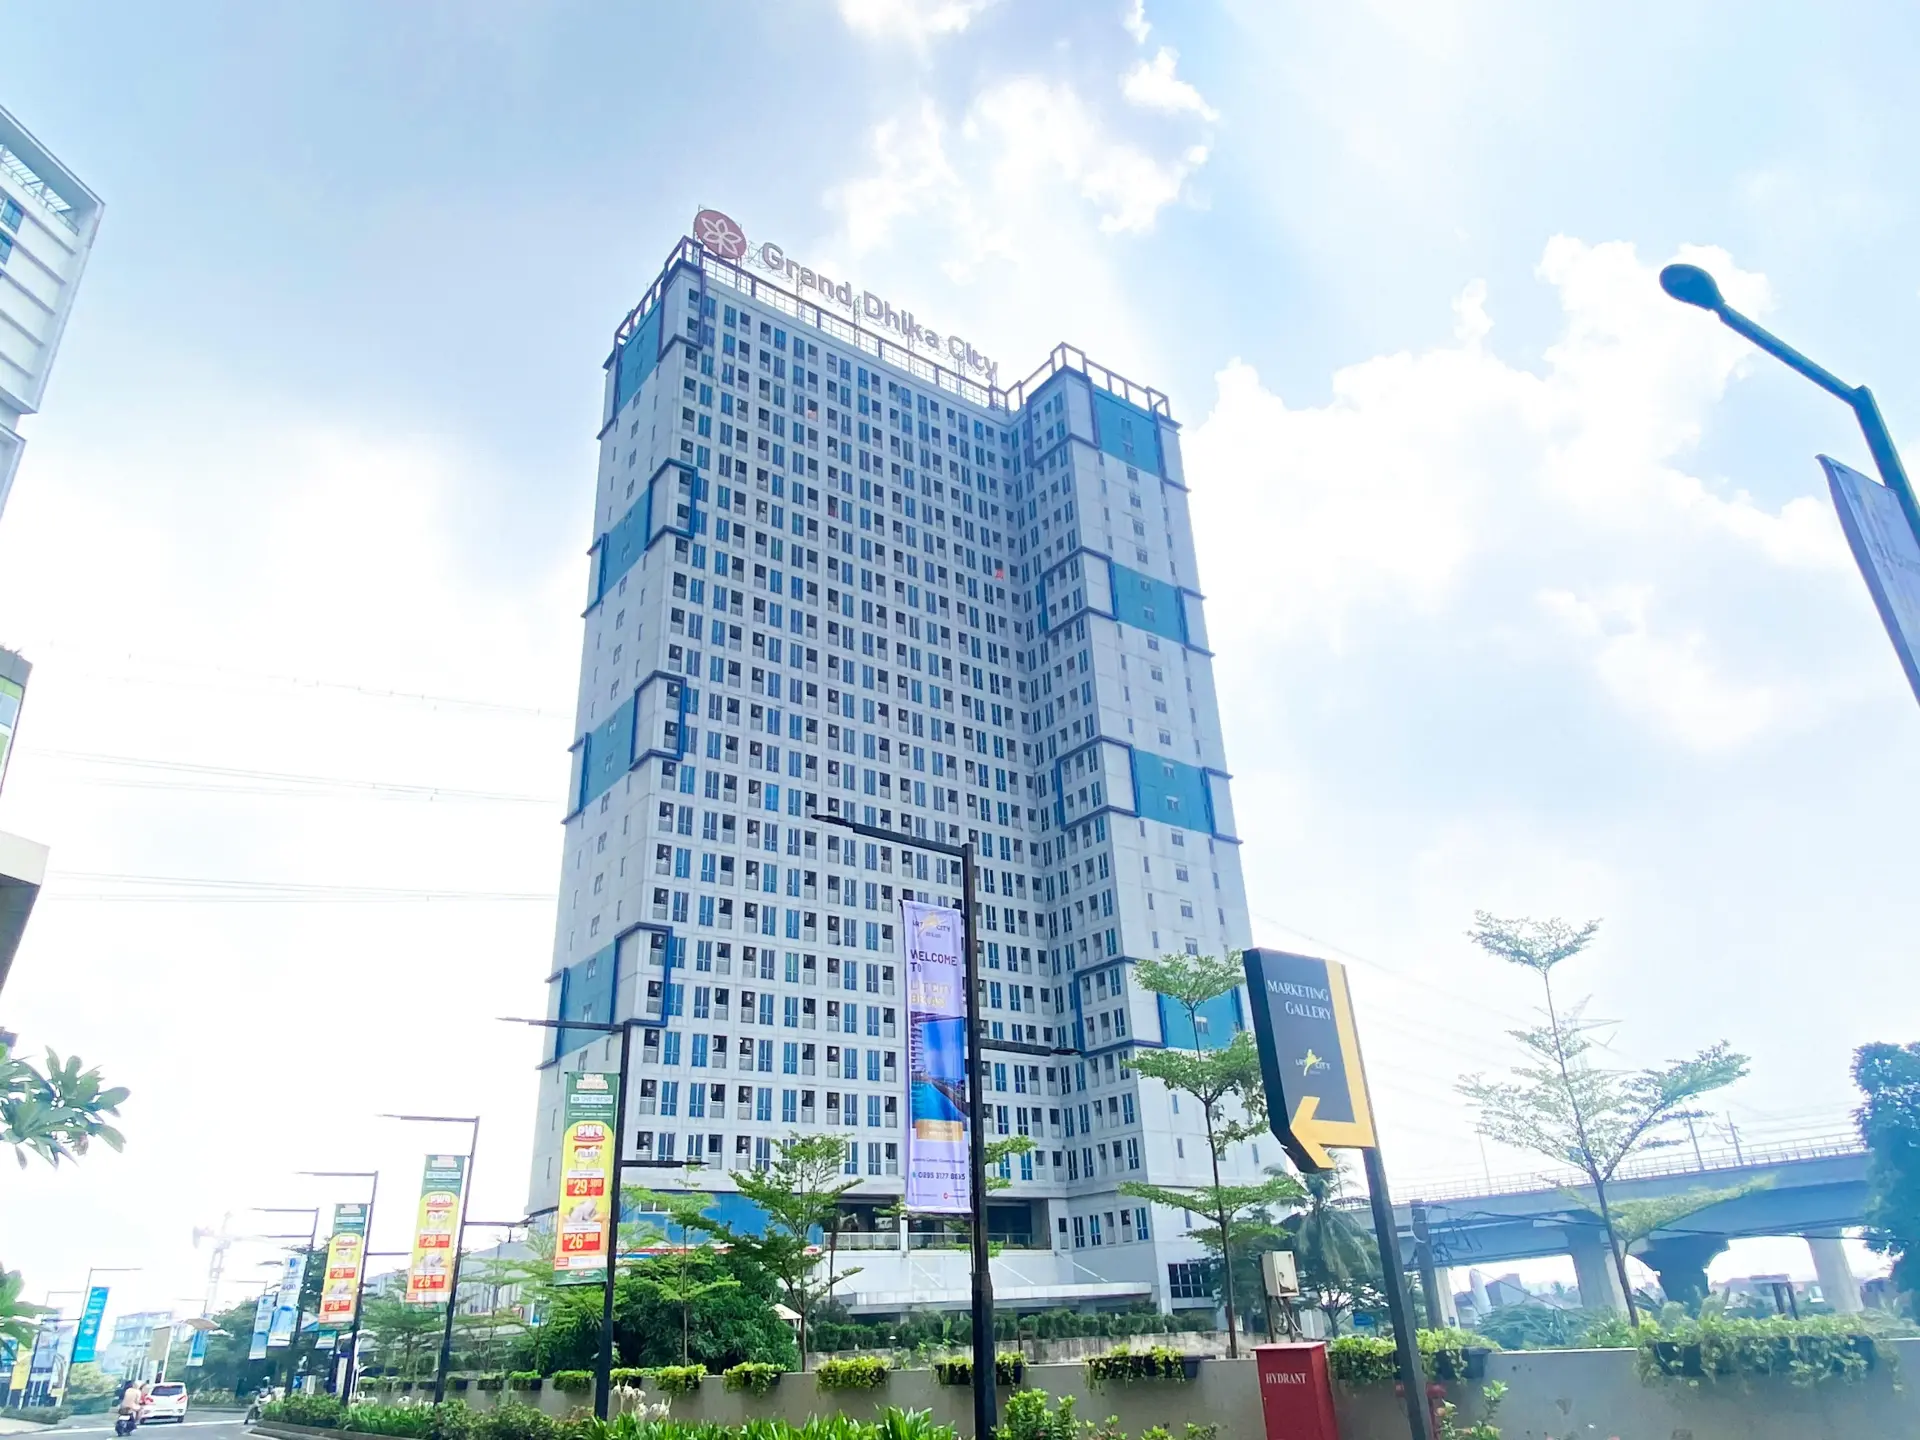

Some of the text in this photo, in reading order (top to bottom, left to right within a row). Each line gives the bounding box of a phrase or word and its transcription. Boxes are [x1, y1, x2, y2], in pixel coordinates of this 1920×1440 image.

[762, 241, 998, 382] Grand Dhika City
[910, 949, 958, 966] WELCOME
[910, 962, 922, 972] TO
[1267, 980, 1329, 1002] MARKETING
[1285, 1001, 1332, 1020] GALLERY
[573, 1179, 588, 1194] 29
[568, 1233, 584, 1249] 26
[1265, 1372, 1307, 1384] HYDRANT
